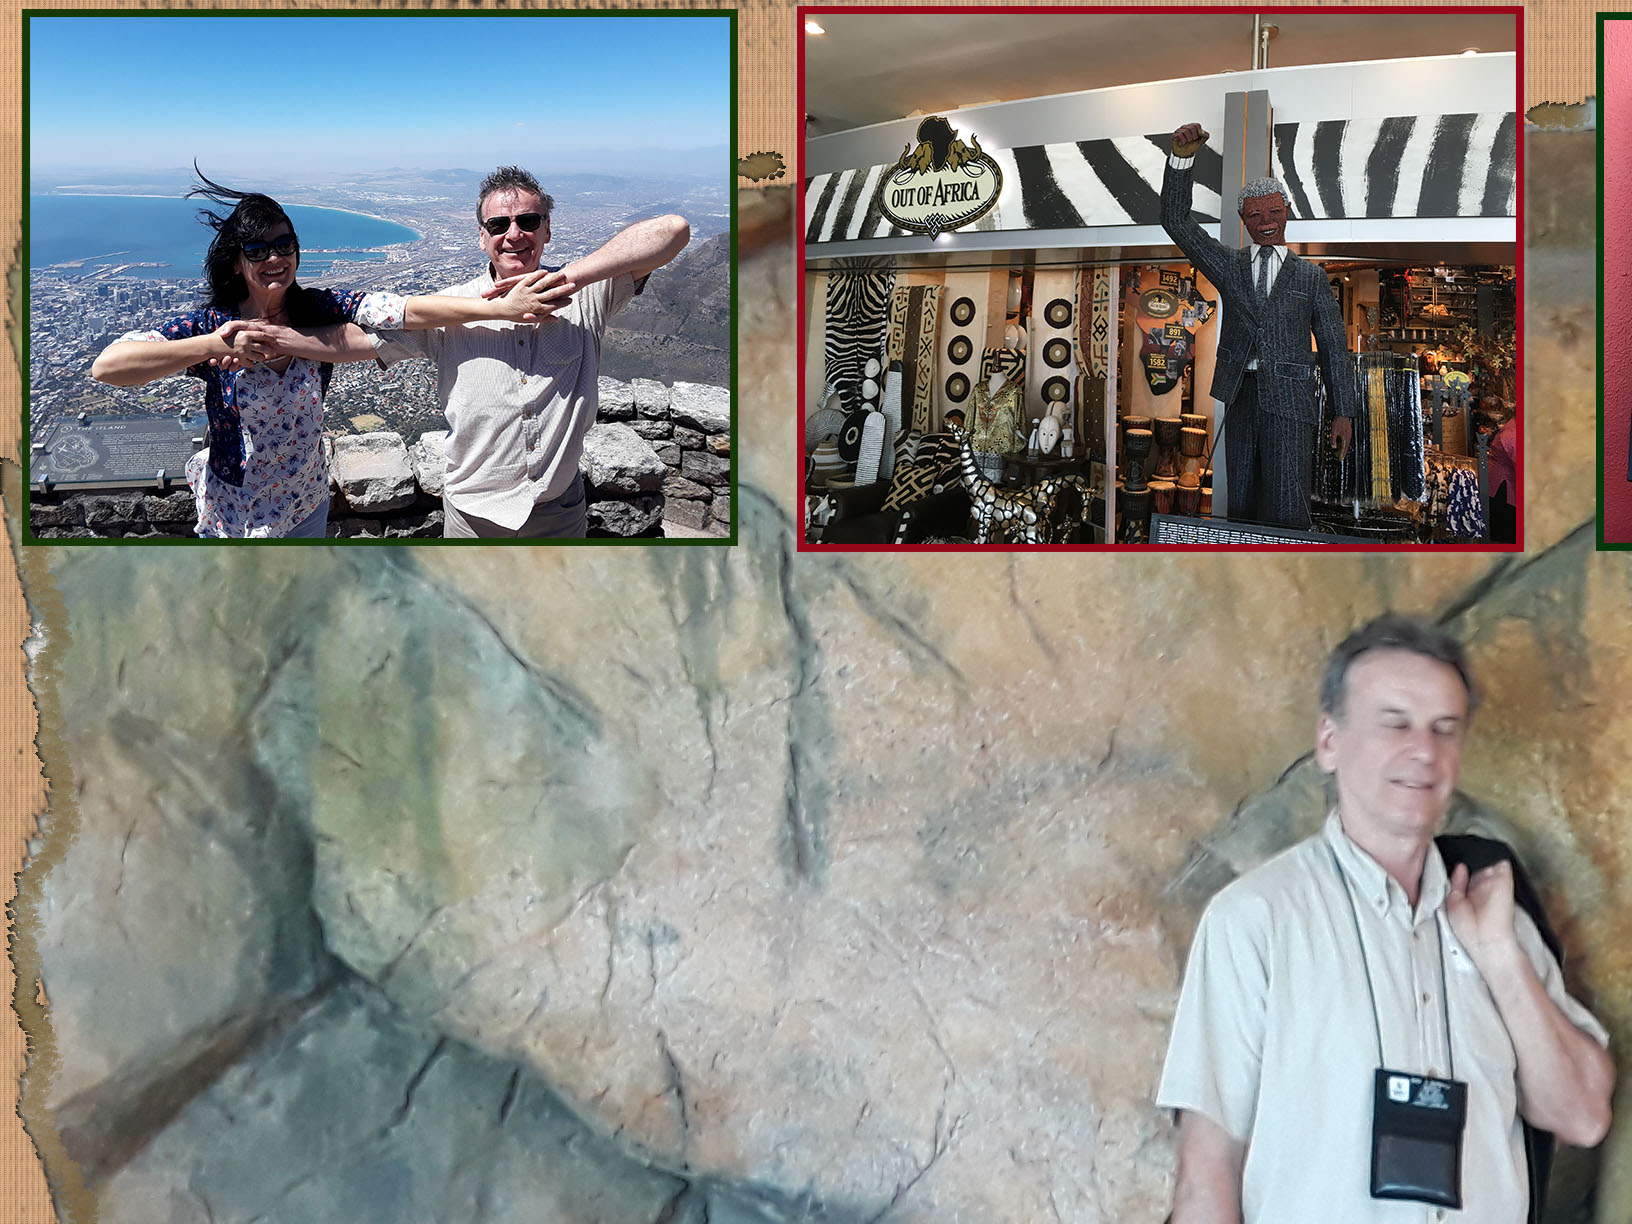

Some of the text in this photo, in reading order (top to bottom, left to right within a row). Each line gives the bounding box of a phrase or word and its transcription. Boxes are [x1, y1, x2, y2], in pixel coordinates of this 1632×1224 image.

[891, 178, 980, 208] OUT OF AFRICA
